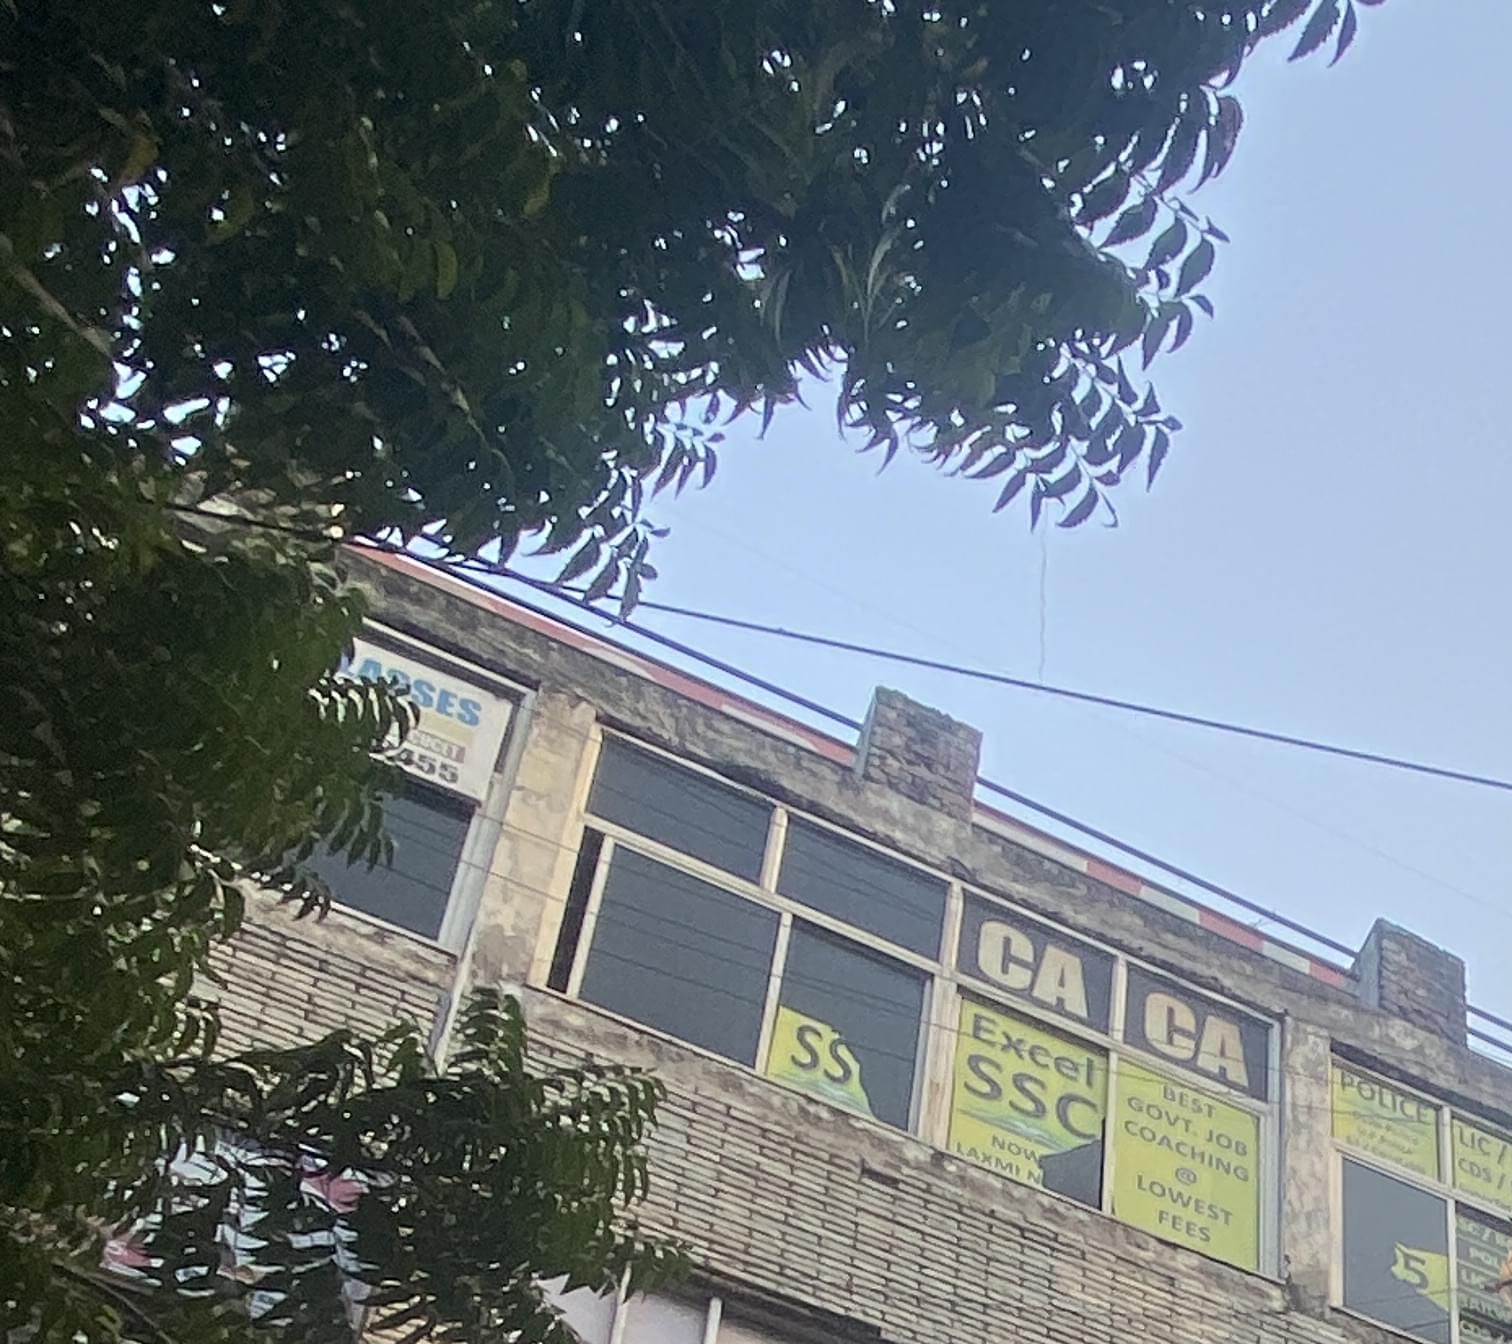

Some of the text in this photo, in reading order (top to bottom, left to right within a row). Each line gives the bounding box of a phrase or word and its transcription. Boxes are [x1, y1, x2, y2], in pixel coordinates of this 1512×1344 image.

[978, 920, 1089, 1019] CA
[972, 1012, 1096, 1088] Excel
[1144, 992, 1250, 1088] CA
[964, 1054, 1100, 1140] SSC
[1162, 1084, 1217, 1120] BEST
[1339, 1070, 1429, 1125] POLICE
[1124, 1120, 1249, 1184] COACHING
[1206, 1128, 1248, 1157] JOB
[1136, 1173, 1234, 1227] LOWEST
[1158, 1210, 1213, 1244] FEES
